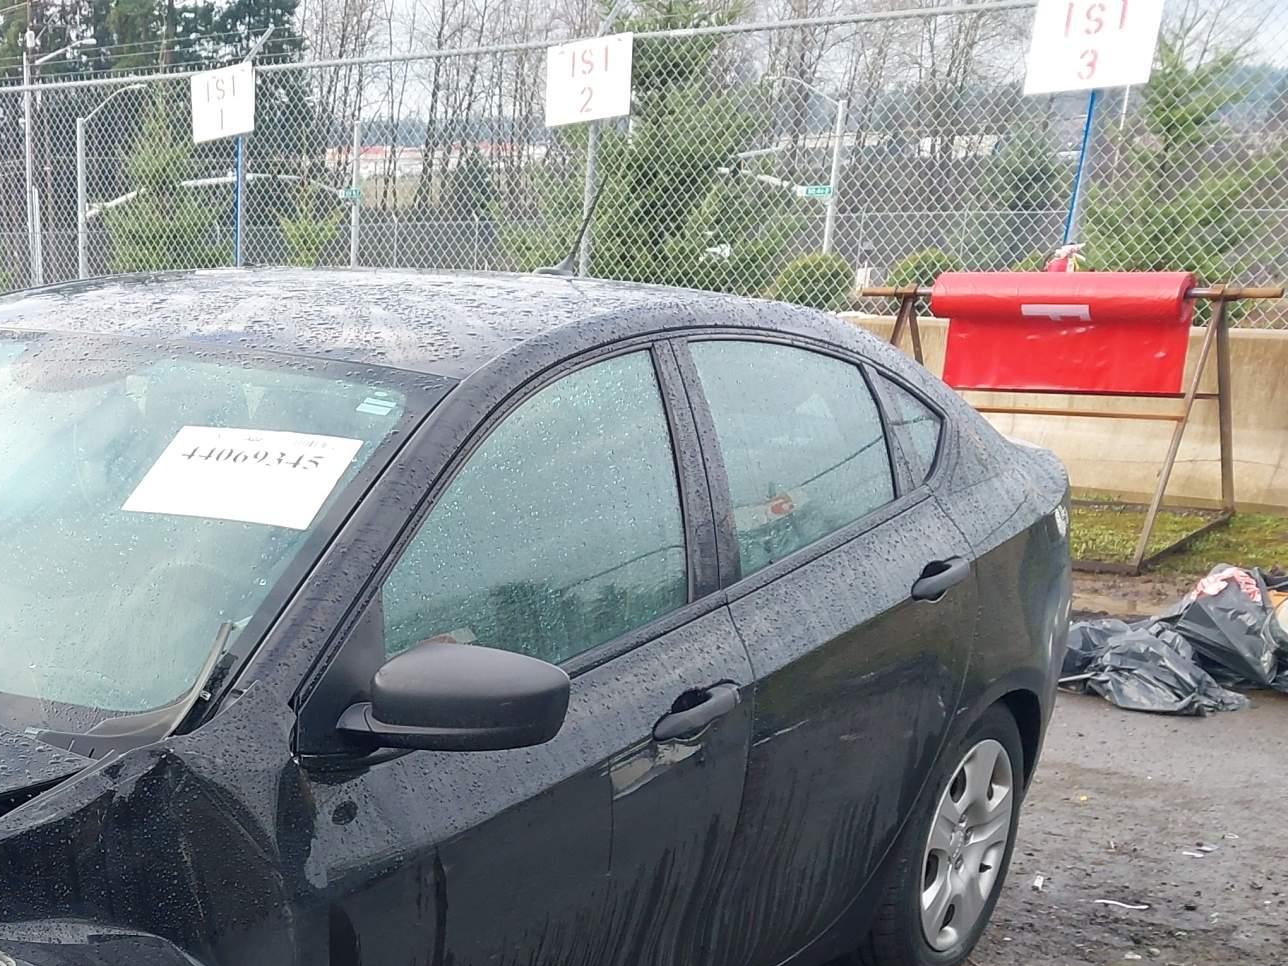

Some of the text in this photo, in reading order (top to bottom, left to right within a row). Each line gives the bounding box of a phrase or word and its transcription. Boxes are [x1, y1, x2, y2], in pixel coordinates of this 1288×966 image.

[1077, 48, 1099, 80] 3
[580, 86, 594, 113] 2
[181, 445, 325, 470] 44069345
